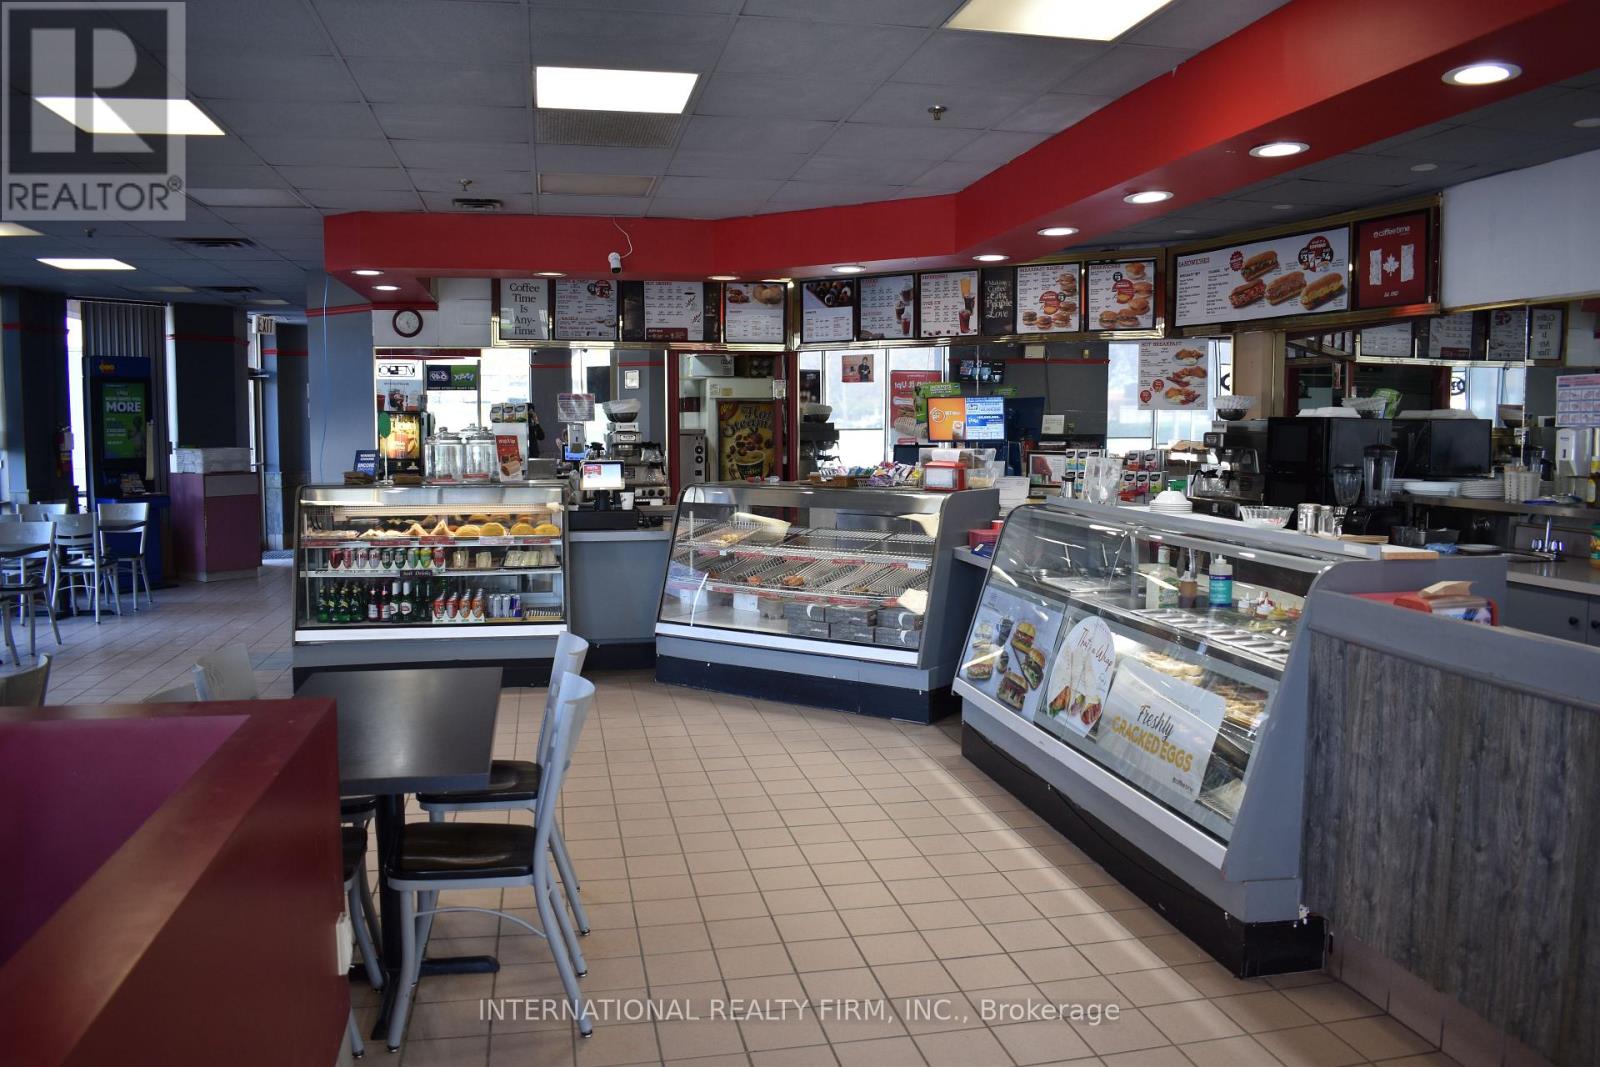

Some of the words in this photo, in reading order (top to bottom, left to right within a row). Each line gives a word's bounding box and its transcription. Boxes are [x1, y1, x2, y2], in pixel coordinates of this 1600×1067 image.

[510, 282, 541, 294] Coffee
[512, 294, 537, 304] Time
[520, 305, 528, 313] Is
[985, 310, 1009, 319] Love
[258, 317, 273, 333] EXIT
[514, 316, 536, 326] Any-
[513, 326, 536, 336] Time
[105, 402, 142, 413] MORE
[1137, 704, 1175, 742] Freshly
[1111, 716, 1162, 755] CRACKED
[1160, 742, 1194, 773] EGGS
